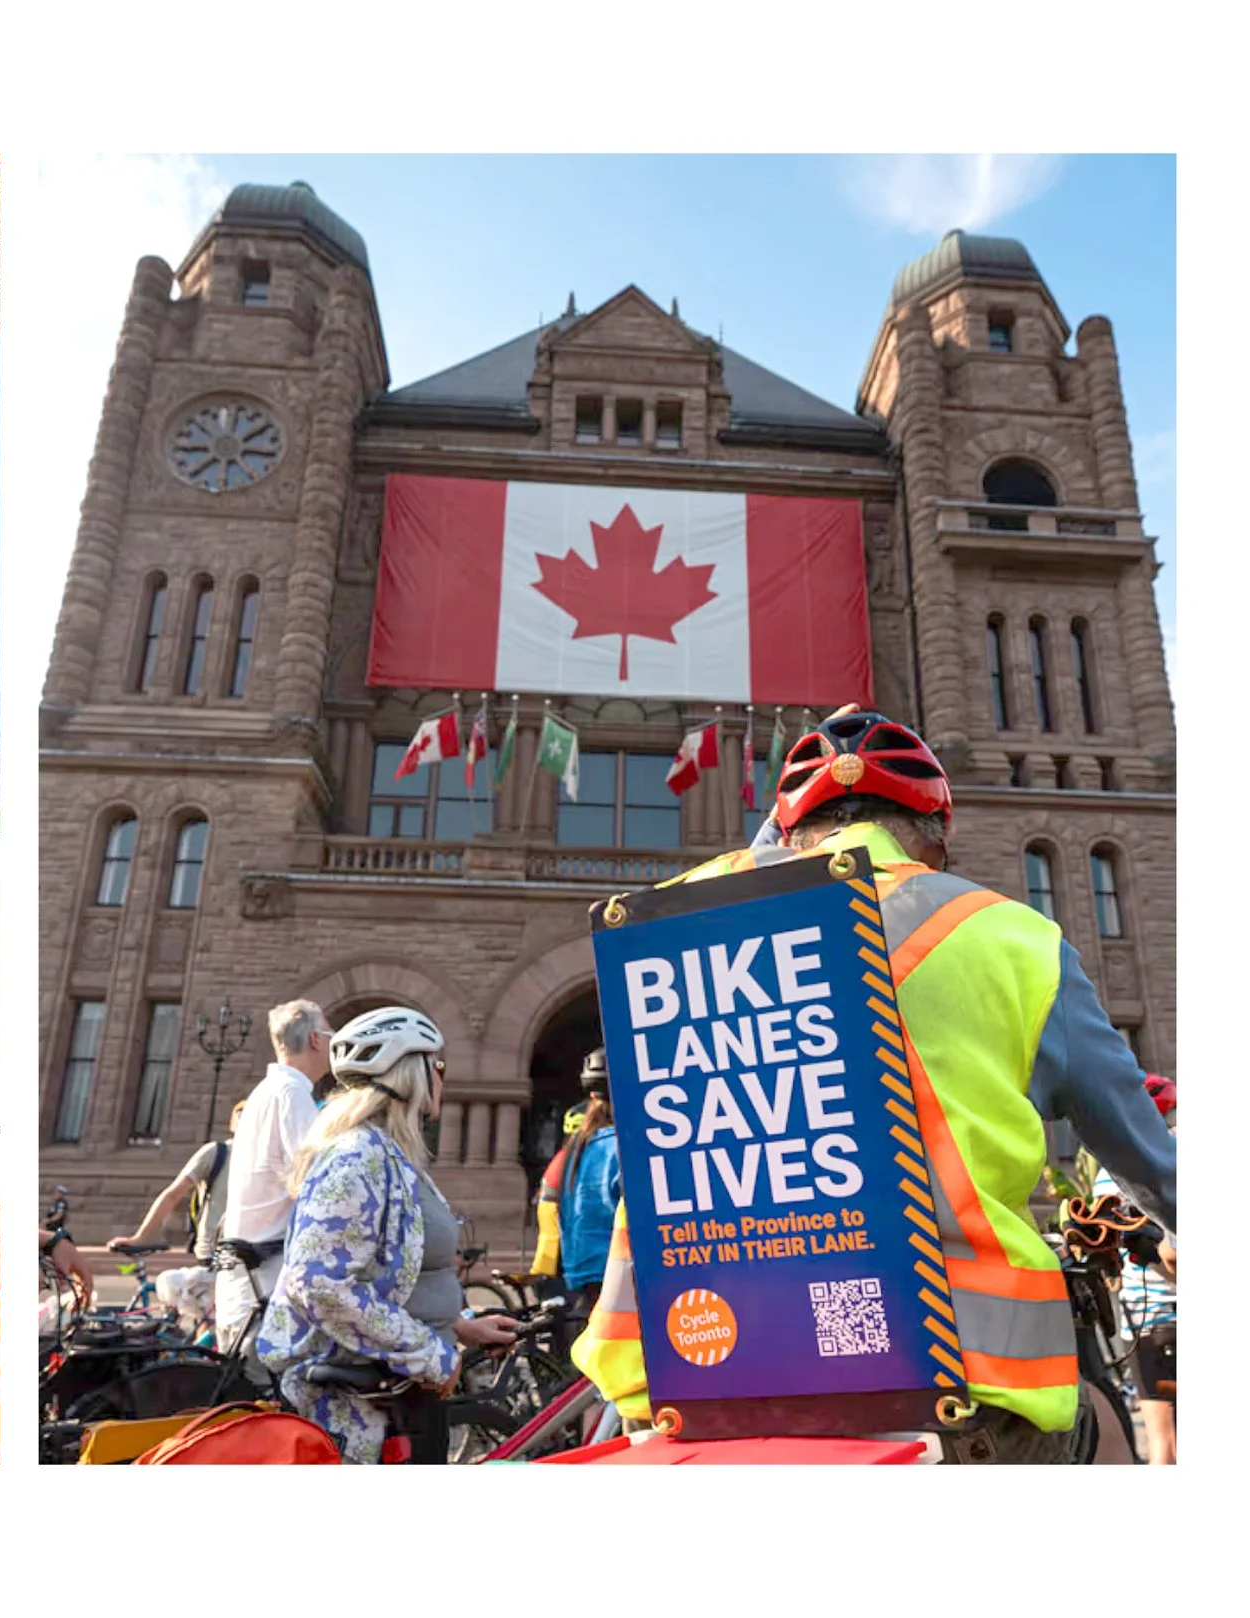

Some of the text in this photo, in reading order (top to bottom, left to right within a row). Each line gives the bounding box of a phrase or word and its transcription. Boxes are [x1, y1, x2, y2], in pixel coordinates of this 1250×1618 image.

[624, 926, 832, 1029] BIKE
[633, 1004, 839, 1083] LANES
[643, 1059, 855, 1149] SAVE
[649, 1133, 864, 1216] LIVES
[658, 1207, 865, 1245] Tell the Province to
[661, 1230, 876, 1268] STAY IN THEIR LANE.
[675, 1324, 731, 1347] Toronto
[679, 1309, 720, 1332] Cycle
